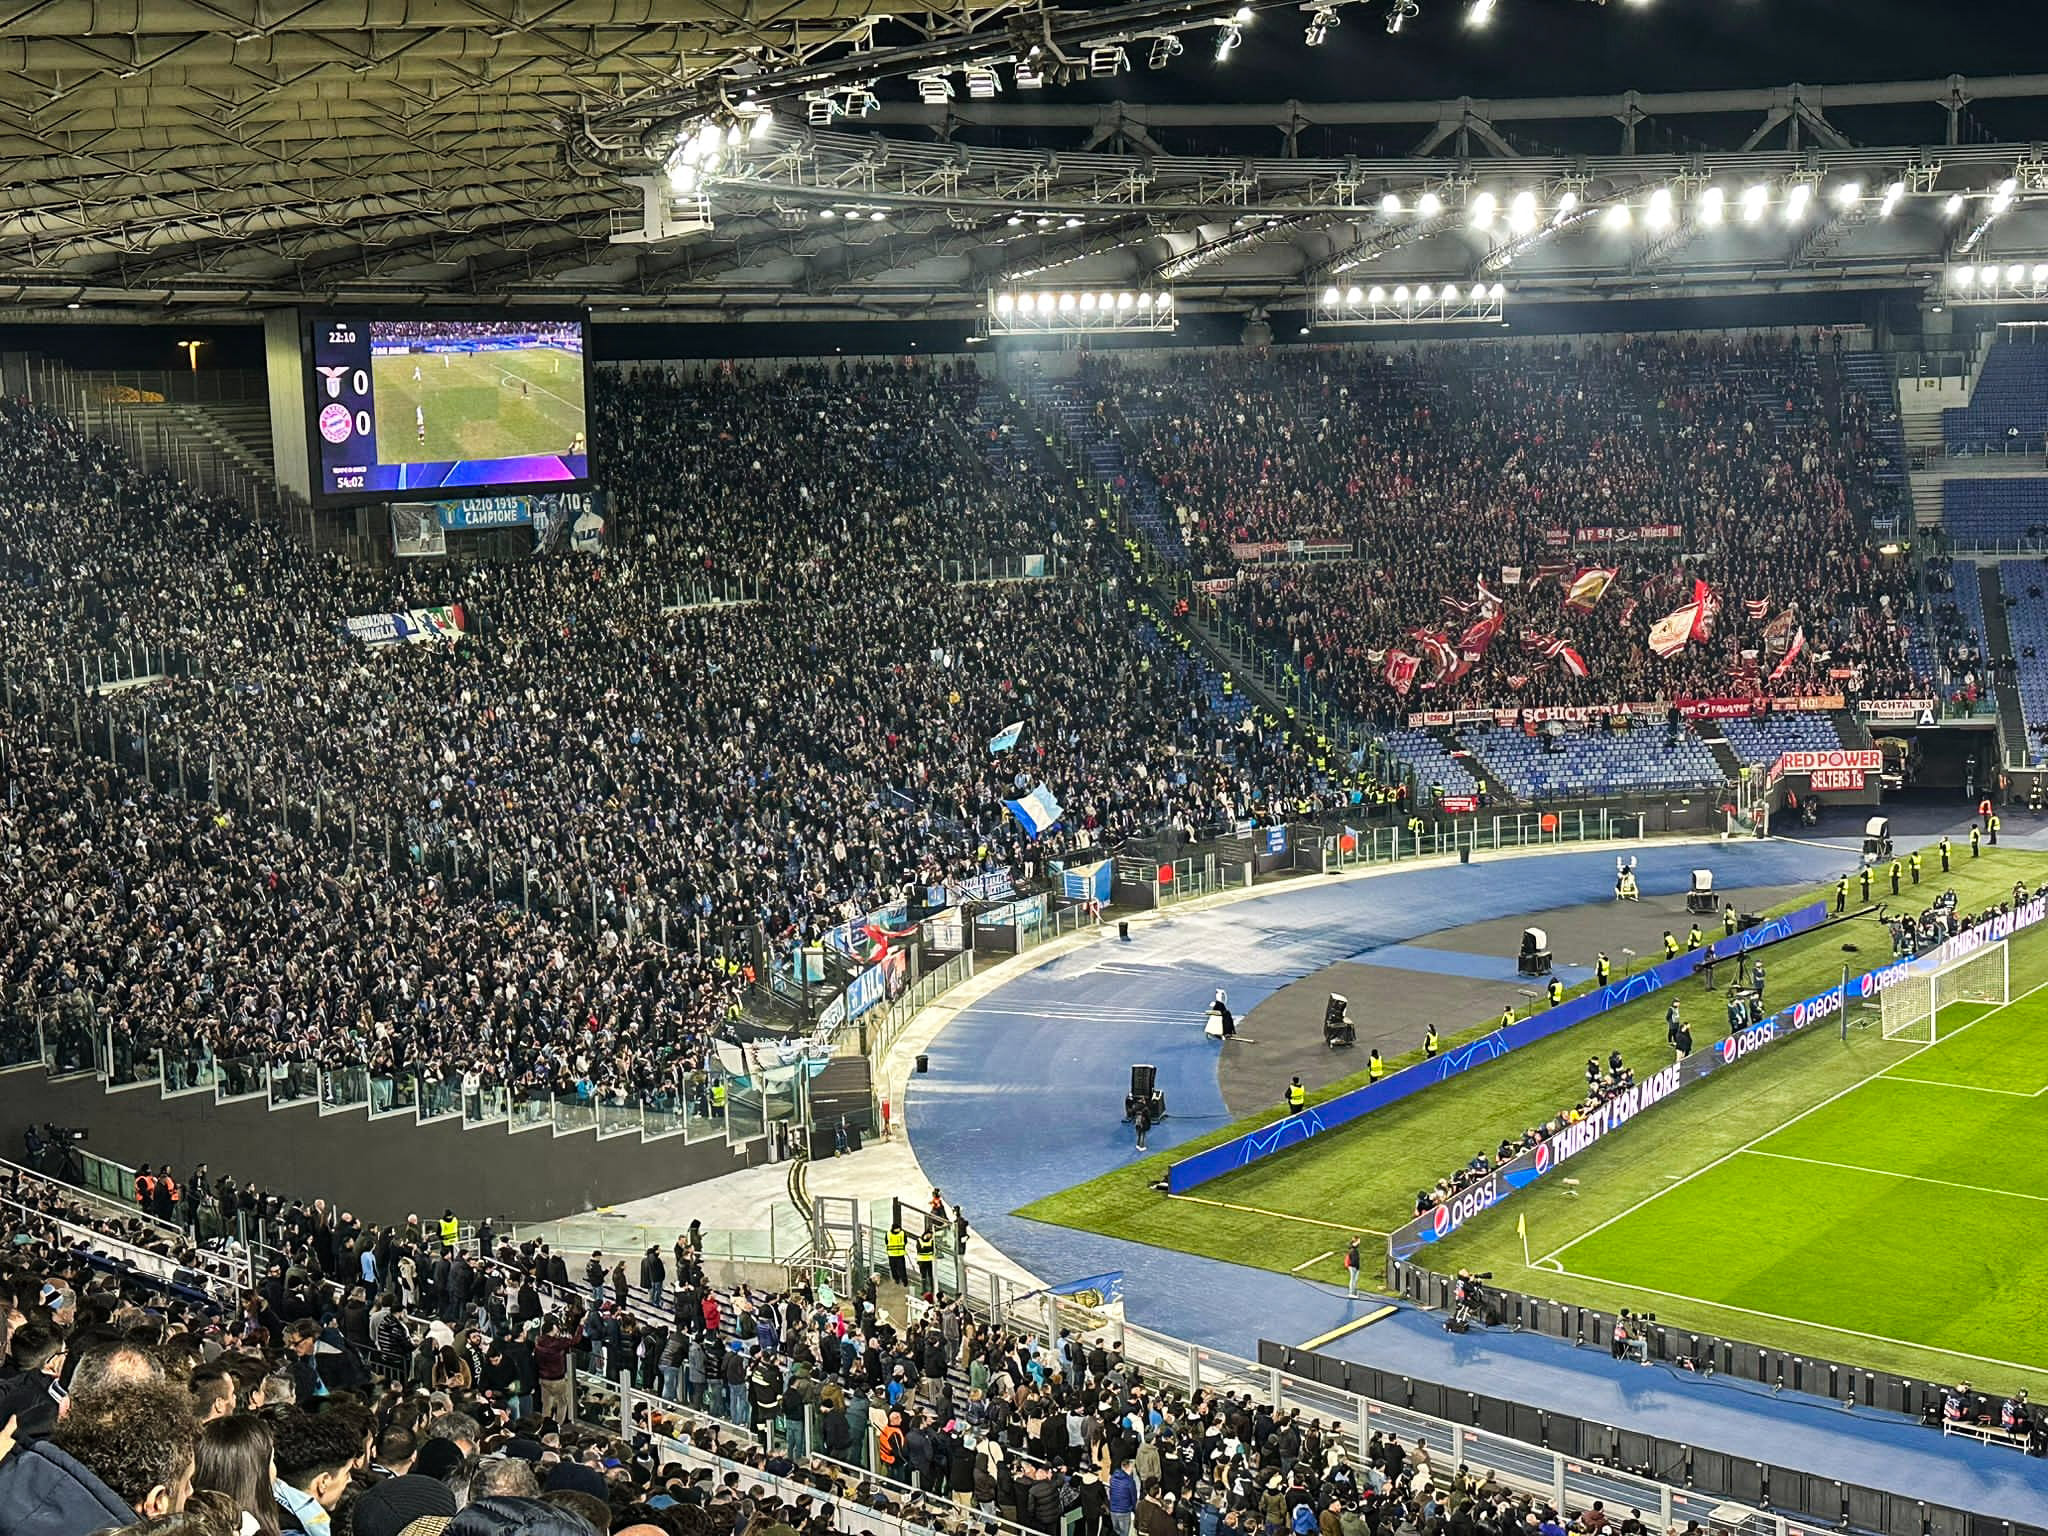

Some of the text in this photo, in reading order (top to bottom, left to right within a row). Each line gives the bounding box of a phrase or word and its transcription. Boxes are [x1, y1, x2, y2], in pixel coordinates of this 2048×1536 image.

[329, 331, 356, 343] 22:10
[353, 370, 369, 396] 0
[356, 410, 371, 436] 0
[337, 475, 364, 489] 54:02
[462, 496, 518, 512] LAZIO 1915
[465, 509, 518, 525] CAMPIONE
[1919, 709, 1935, 725] A
[1784, 751, 1880, 768] RED POWER
[1811, 769, 1850, 788] SELTERS
[1949, 895, 2046, 961] THIRSTY FOR MORE
[1873, 957, 1909, 994] pepsi
[1806, 985, 1842, 1025] pepsi
[1736, 1015, 1774, 1058] pepsi
[1551, 1062, 1681, 1165] THIRSTY FOR MORE
[1451, 1173, 1497, 1228] pepsi
